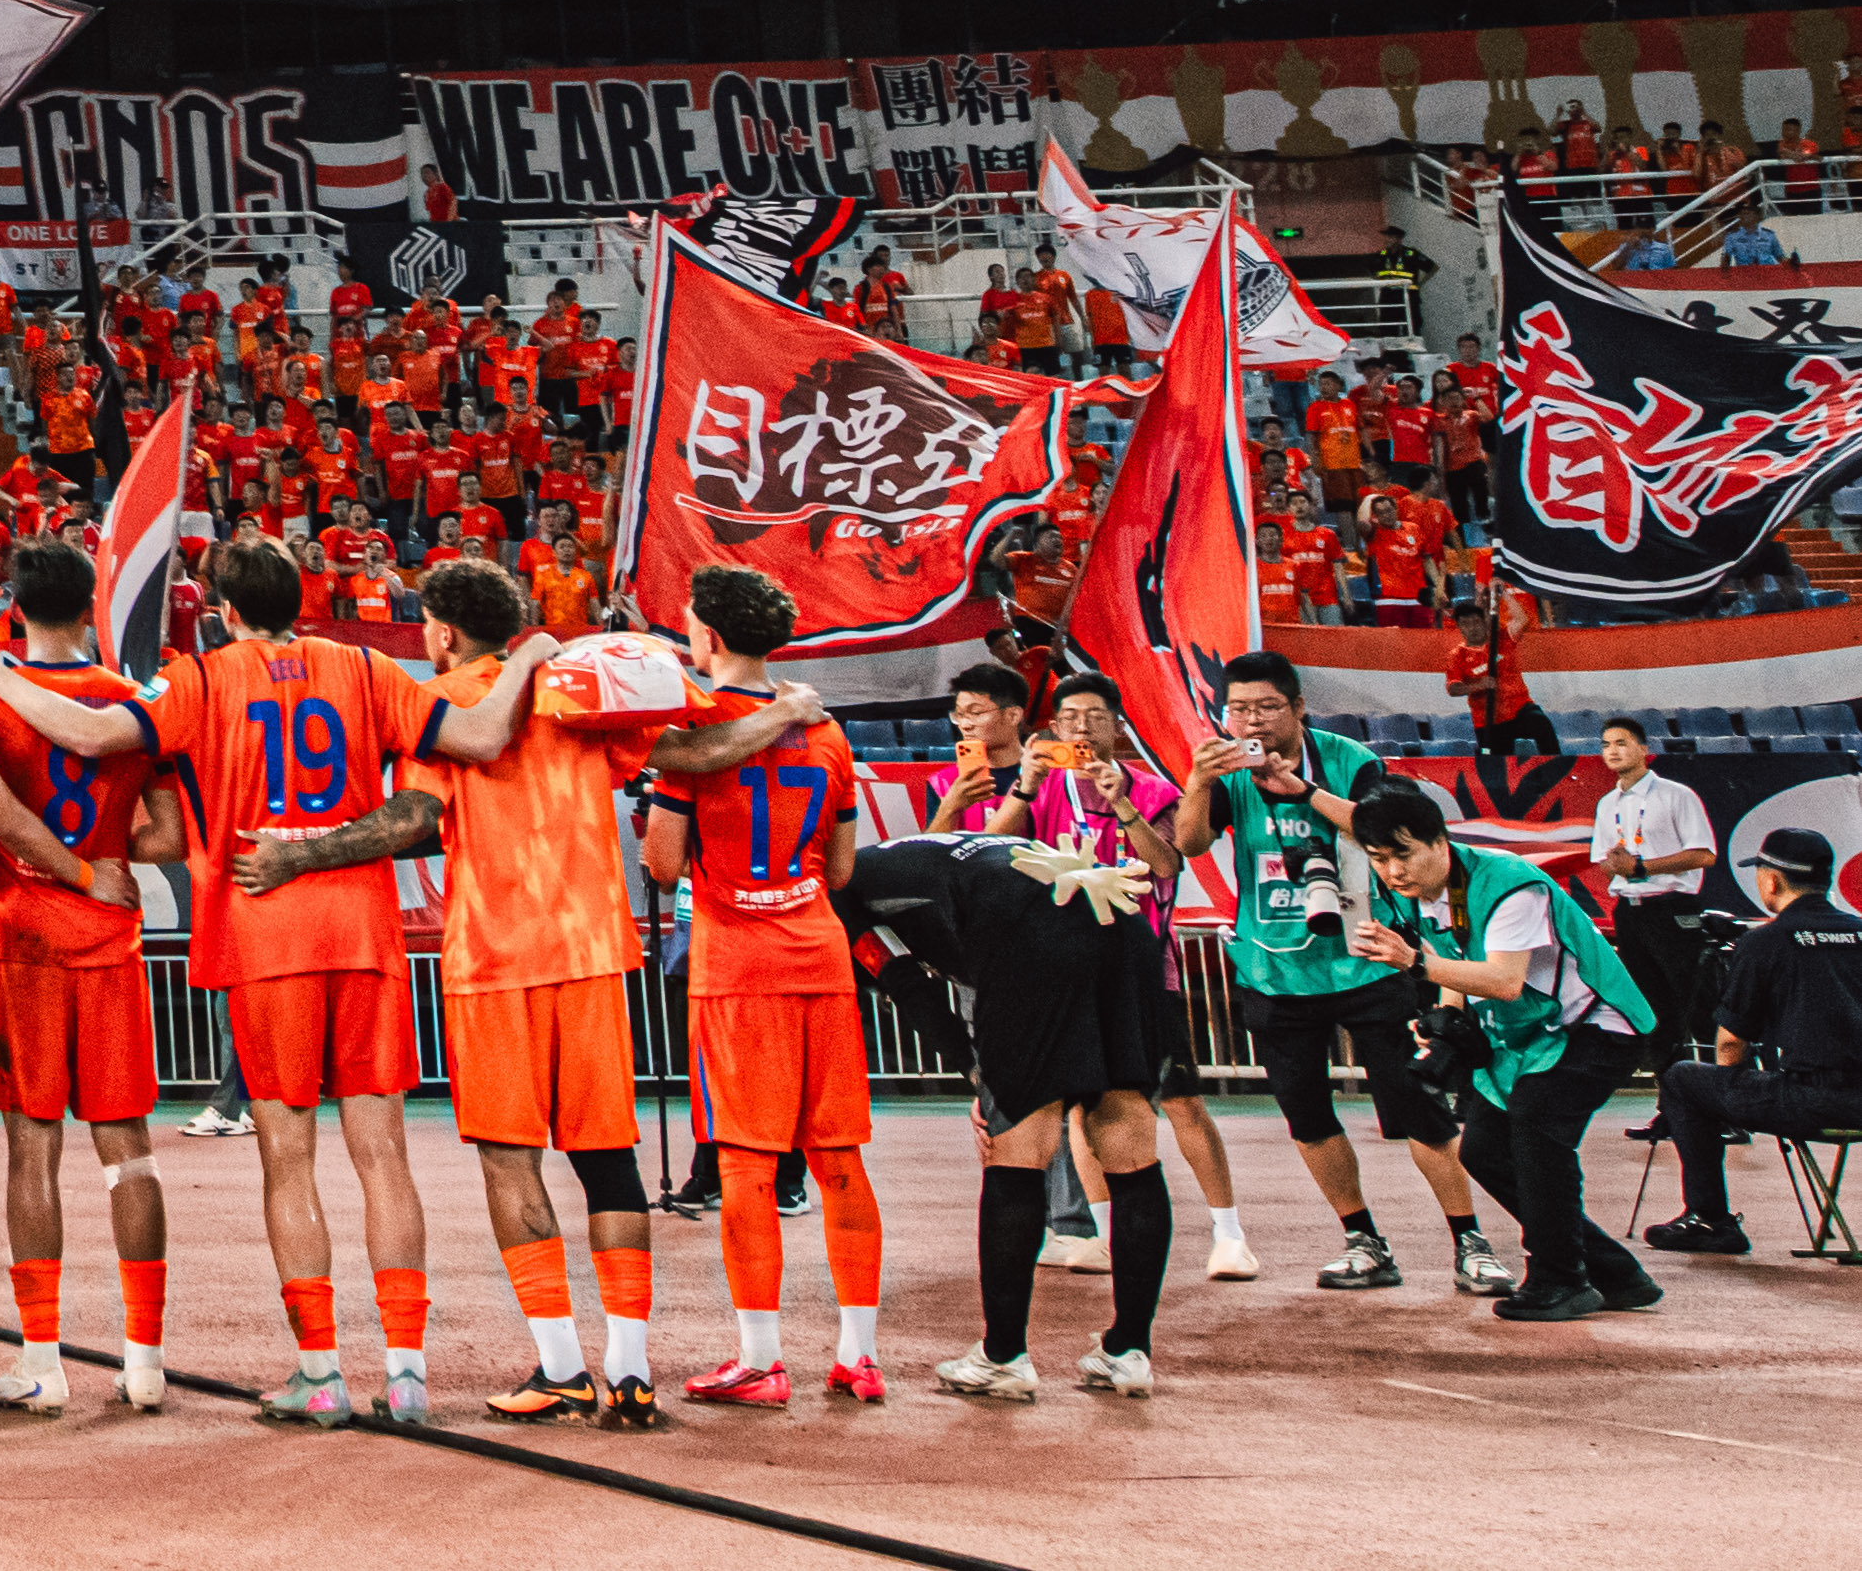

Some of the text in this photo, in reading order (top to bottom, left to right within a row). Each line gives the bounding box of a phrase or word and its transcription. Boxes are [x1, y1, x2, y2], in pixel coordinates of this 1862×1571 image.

[869, 52, 1032, 131] 團結
[414, 70, 873, 205] WE ARE ONE
[7, 224, 51, 242] ONE
[836, 518, 882, 538] Go
[43, 745, 99, 848] 8
[247, 698, 347, 816] 19
[738, 765, 828, 882] 17
[1816, 931, 1856, 944] SWAT
